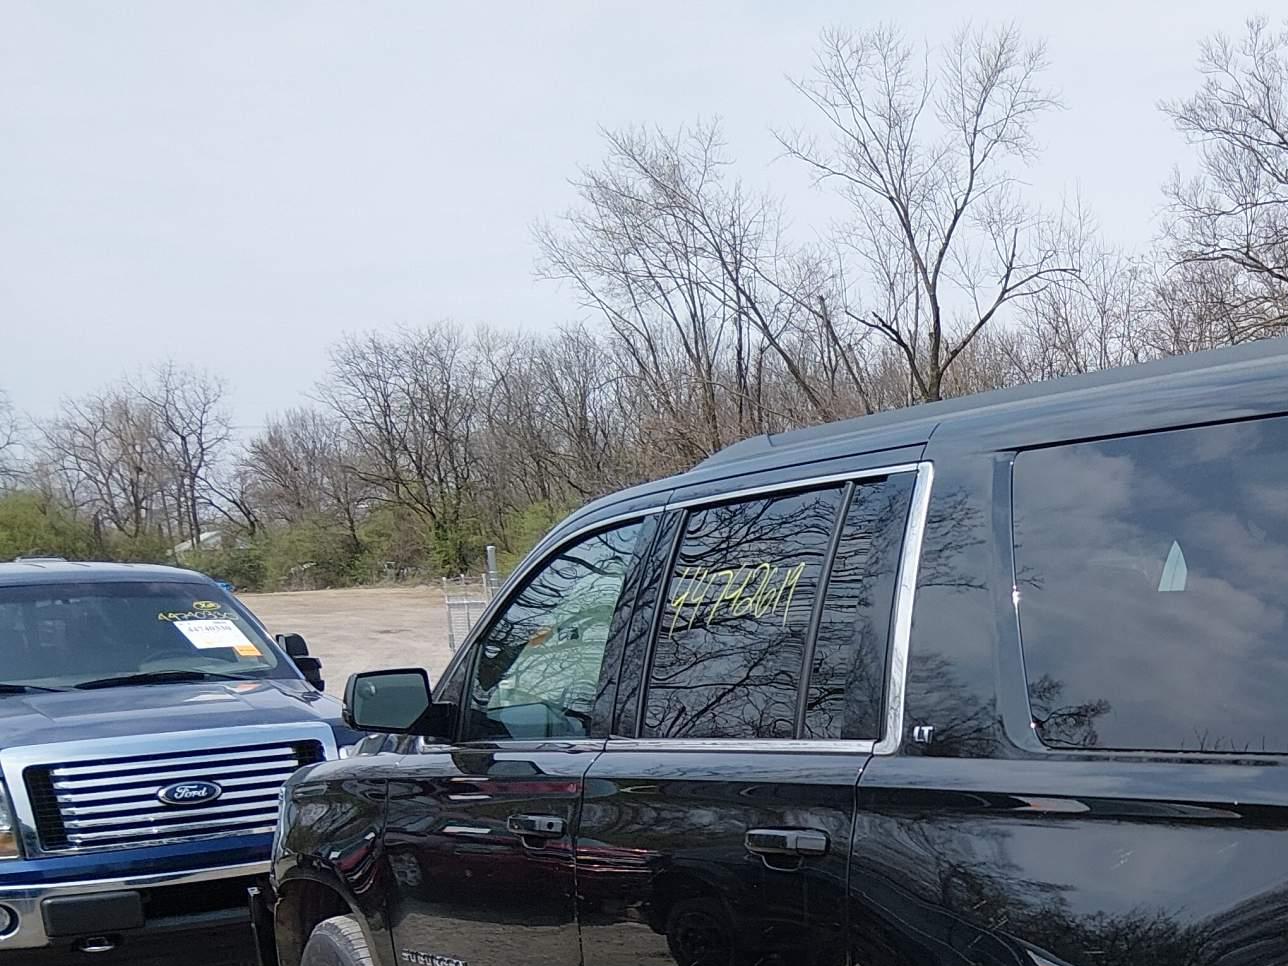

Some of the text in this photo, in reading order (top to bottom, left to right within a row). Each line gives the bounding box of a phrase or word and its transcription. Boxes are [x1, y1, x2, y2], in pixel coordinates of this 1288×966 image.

[668, 561, 806, 639] 44742619
[913, 726, 934, 743] LT
[174, 785, 208, 799] Ford
